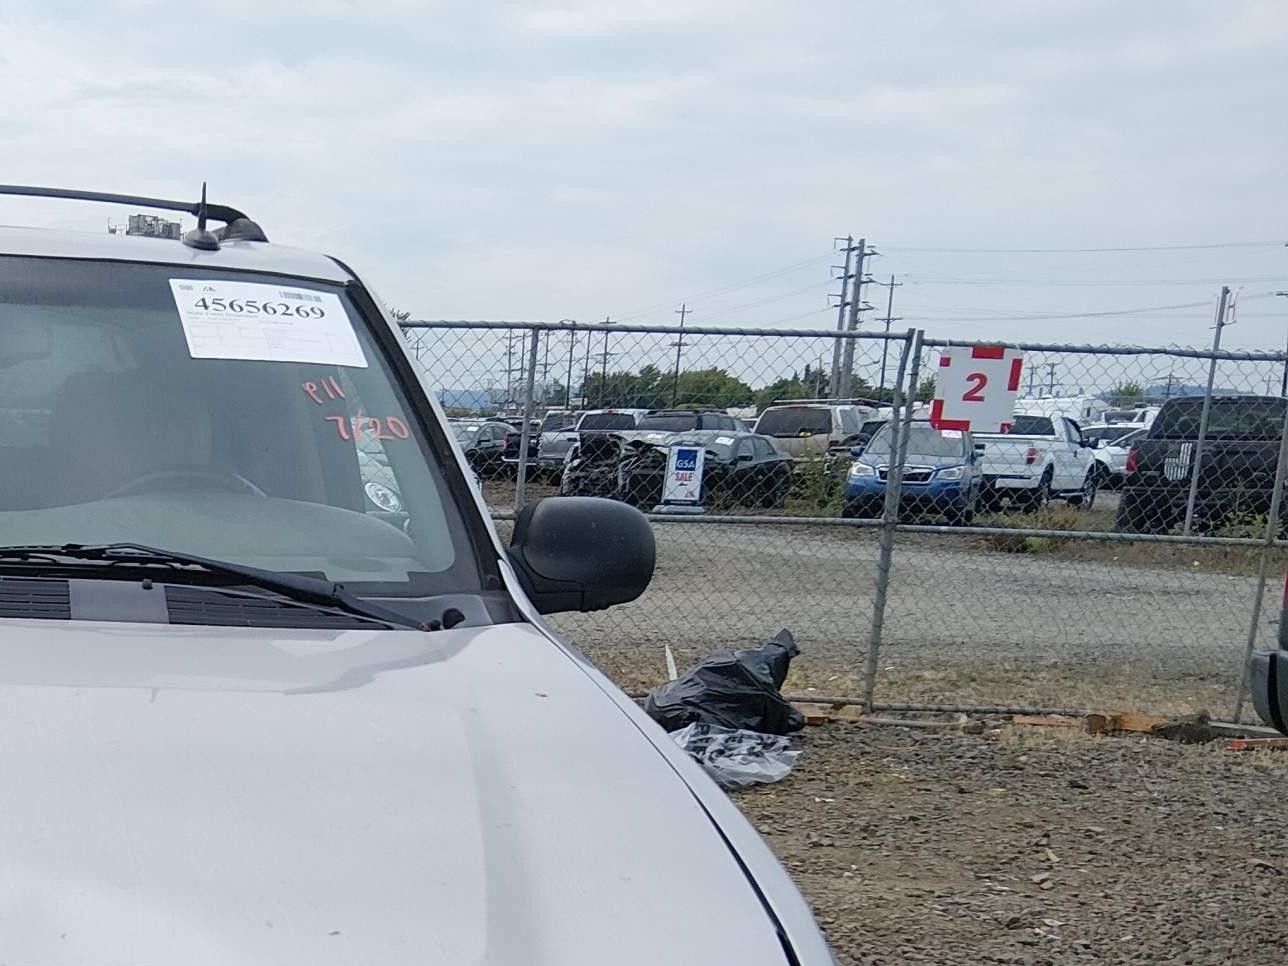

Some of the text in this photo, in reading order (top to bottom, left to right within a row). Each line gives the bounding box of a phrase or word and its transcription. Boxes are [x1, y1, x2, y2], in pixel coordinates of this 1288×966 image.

[194, 297, 326, 320] 45656269
[962, 373, 988, 402] 2
[325, 408, 409, 442] 7/20
[676, 459, 695, 468] GSA
[674, 471, 694, 482] SALE
